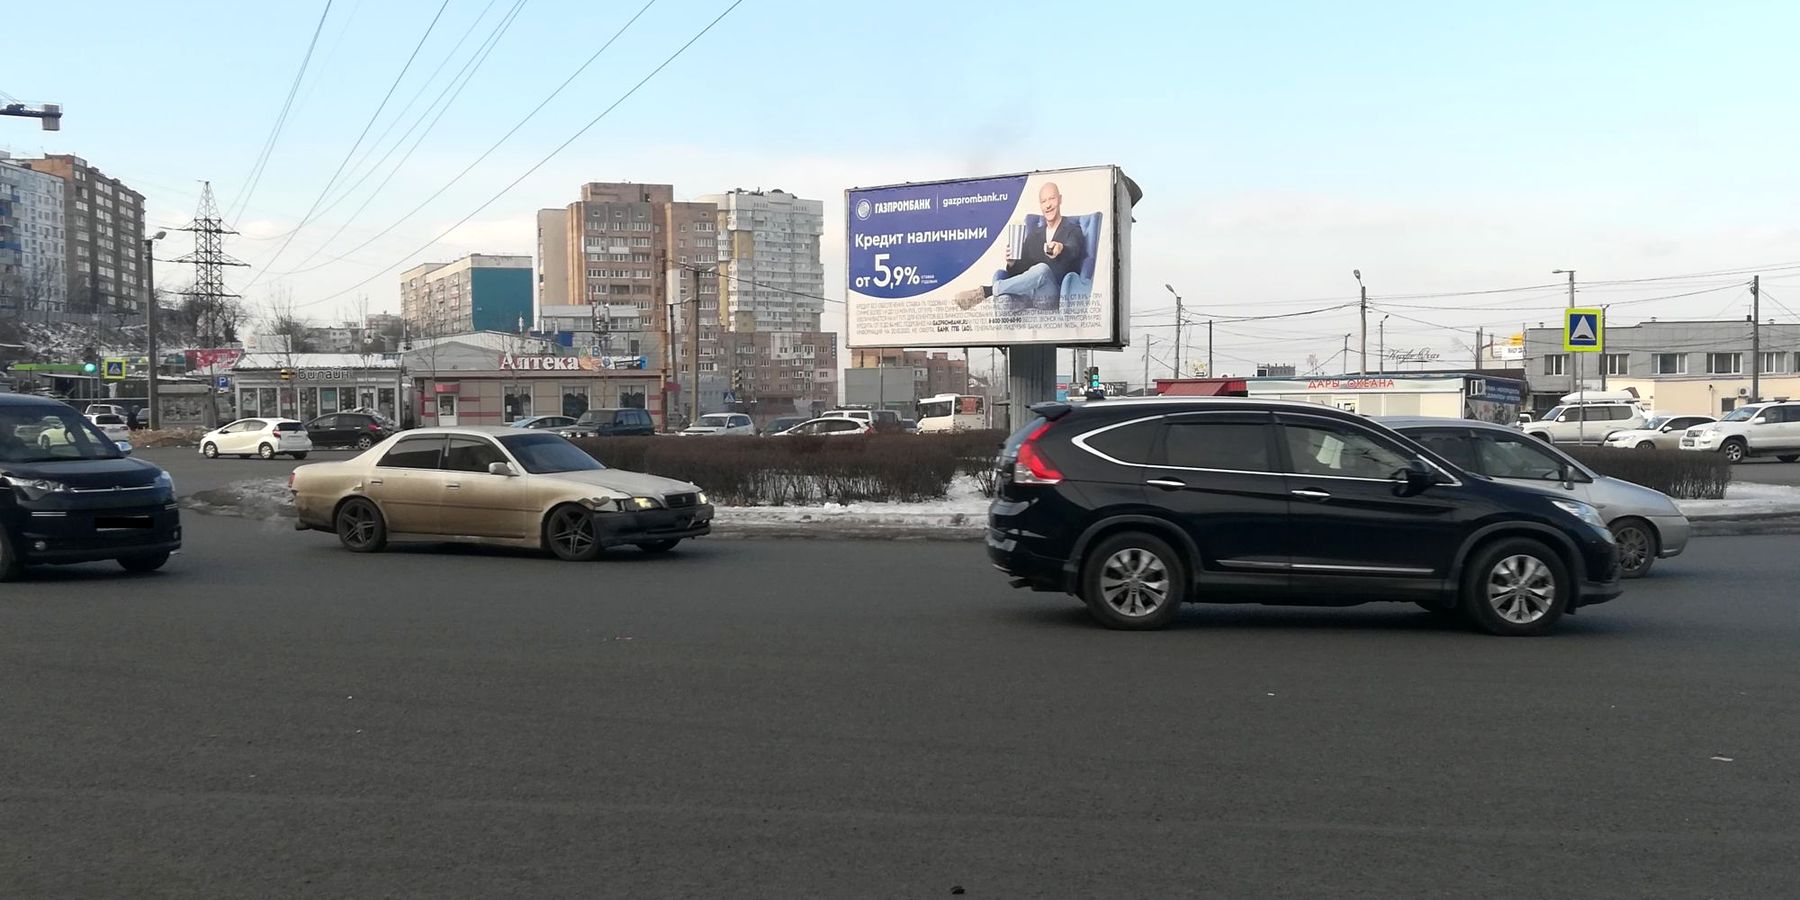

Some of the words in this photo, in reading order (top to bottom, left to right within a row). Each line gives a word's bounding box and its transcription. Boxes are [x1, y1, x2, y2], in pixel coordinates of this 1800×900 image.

[875, 199, 931, 214] ГАЗПРОМБАНК
[943, 192, 1008, 208] gazprombank.ru
[855, 232, 904, 250] Кредит
[907, 226, 988, 244] наличными
[855, 276, 871, 288] от
[873, 253, 920, 290] 5,9%
[499, 352, 580, 370] Аптека
[1308, 379, 1339, 389] ДАРЫ
[1347, 379, 1394, 389] ОКЕАНА
